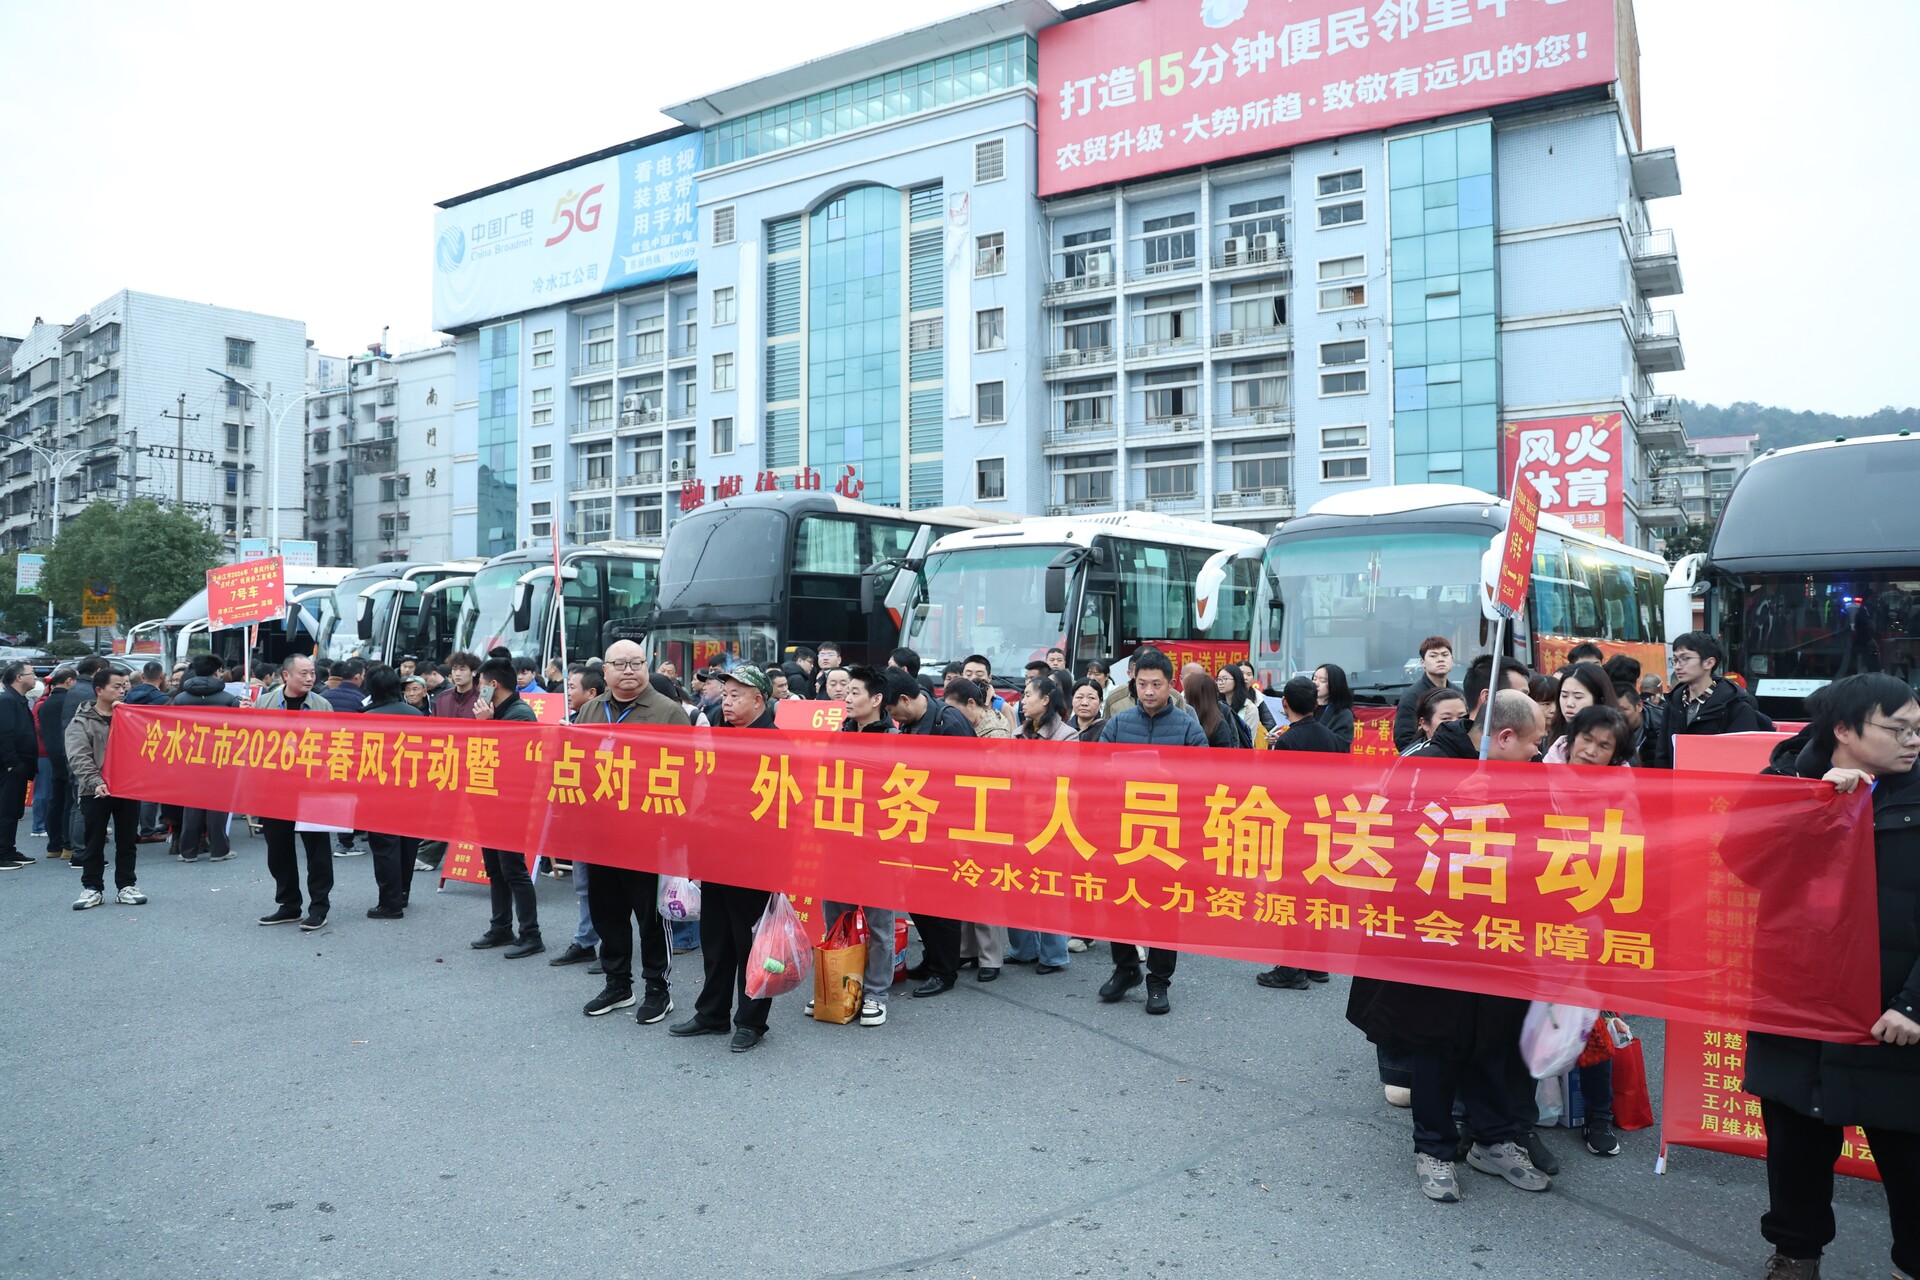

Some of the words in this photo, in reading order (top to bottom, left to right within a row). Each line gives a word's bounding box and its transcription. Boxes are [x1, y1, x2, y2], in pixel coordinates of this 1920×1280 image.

[1059, 0, 1569, 120] 打造15分钟便民邻里
[634, 148, 695, 184] 看电视
[633, 174, 693, 210] 装宽带
[471, 208, 534, 242] 中国广电
[545, 184, 605, 247] 5G
[632, 202, 694, 237] 用手机
[470, 249, 491, 261] China
[494, 237, 534, 255] Broadnet
[532, 263, 598, 294] 冷水江公司
[1518, 425, 1611, 468] 风火
[230, 586, 259, 602] 7号车
[1164, 650, 1249, 677] 春风送岗保
[1703, 1030, 1748, 1050] 刘楚
[1702, 1093, 1762, 1118] 王小南
[1701, 1114, 1763, 1139] 周维林
